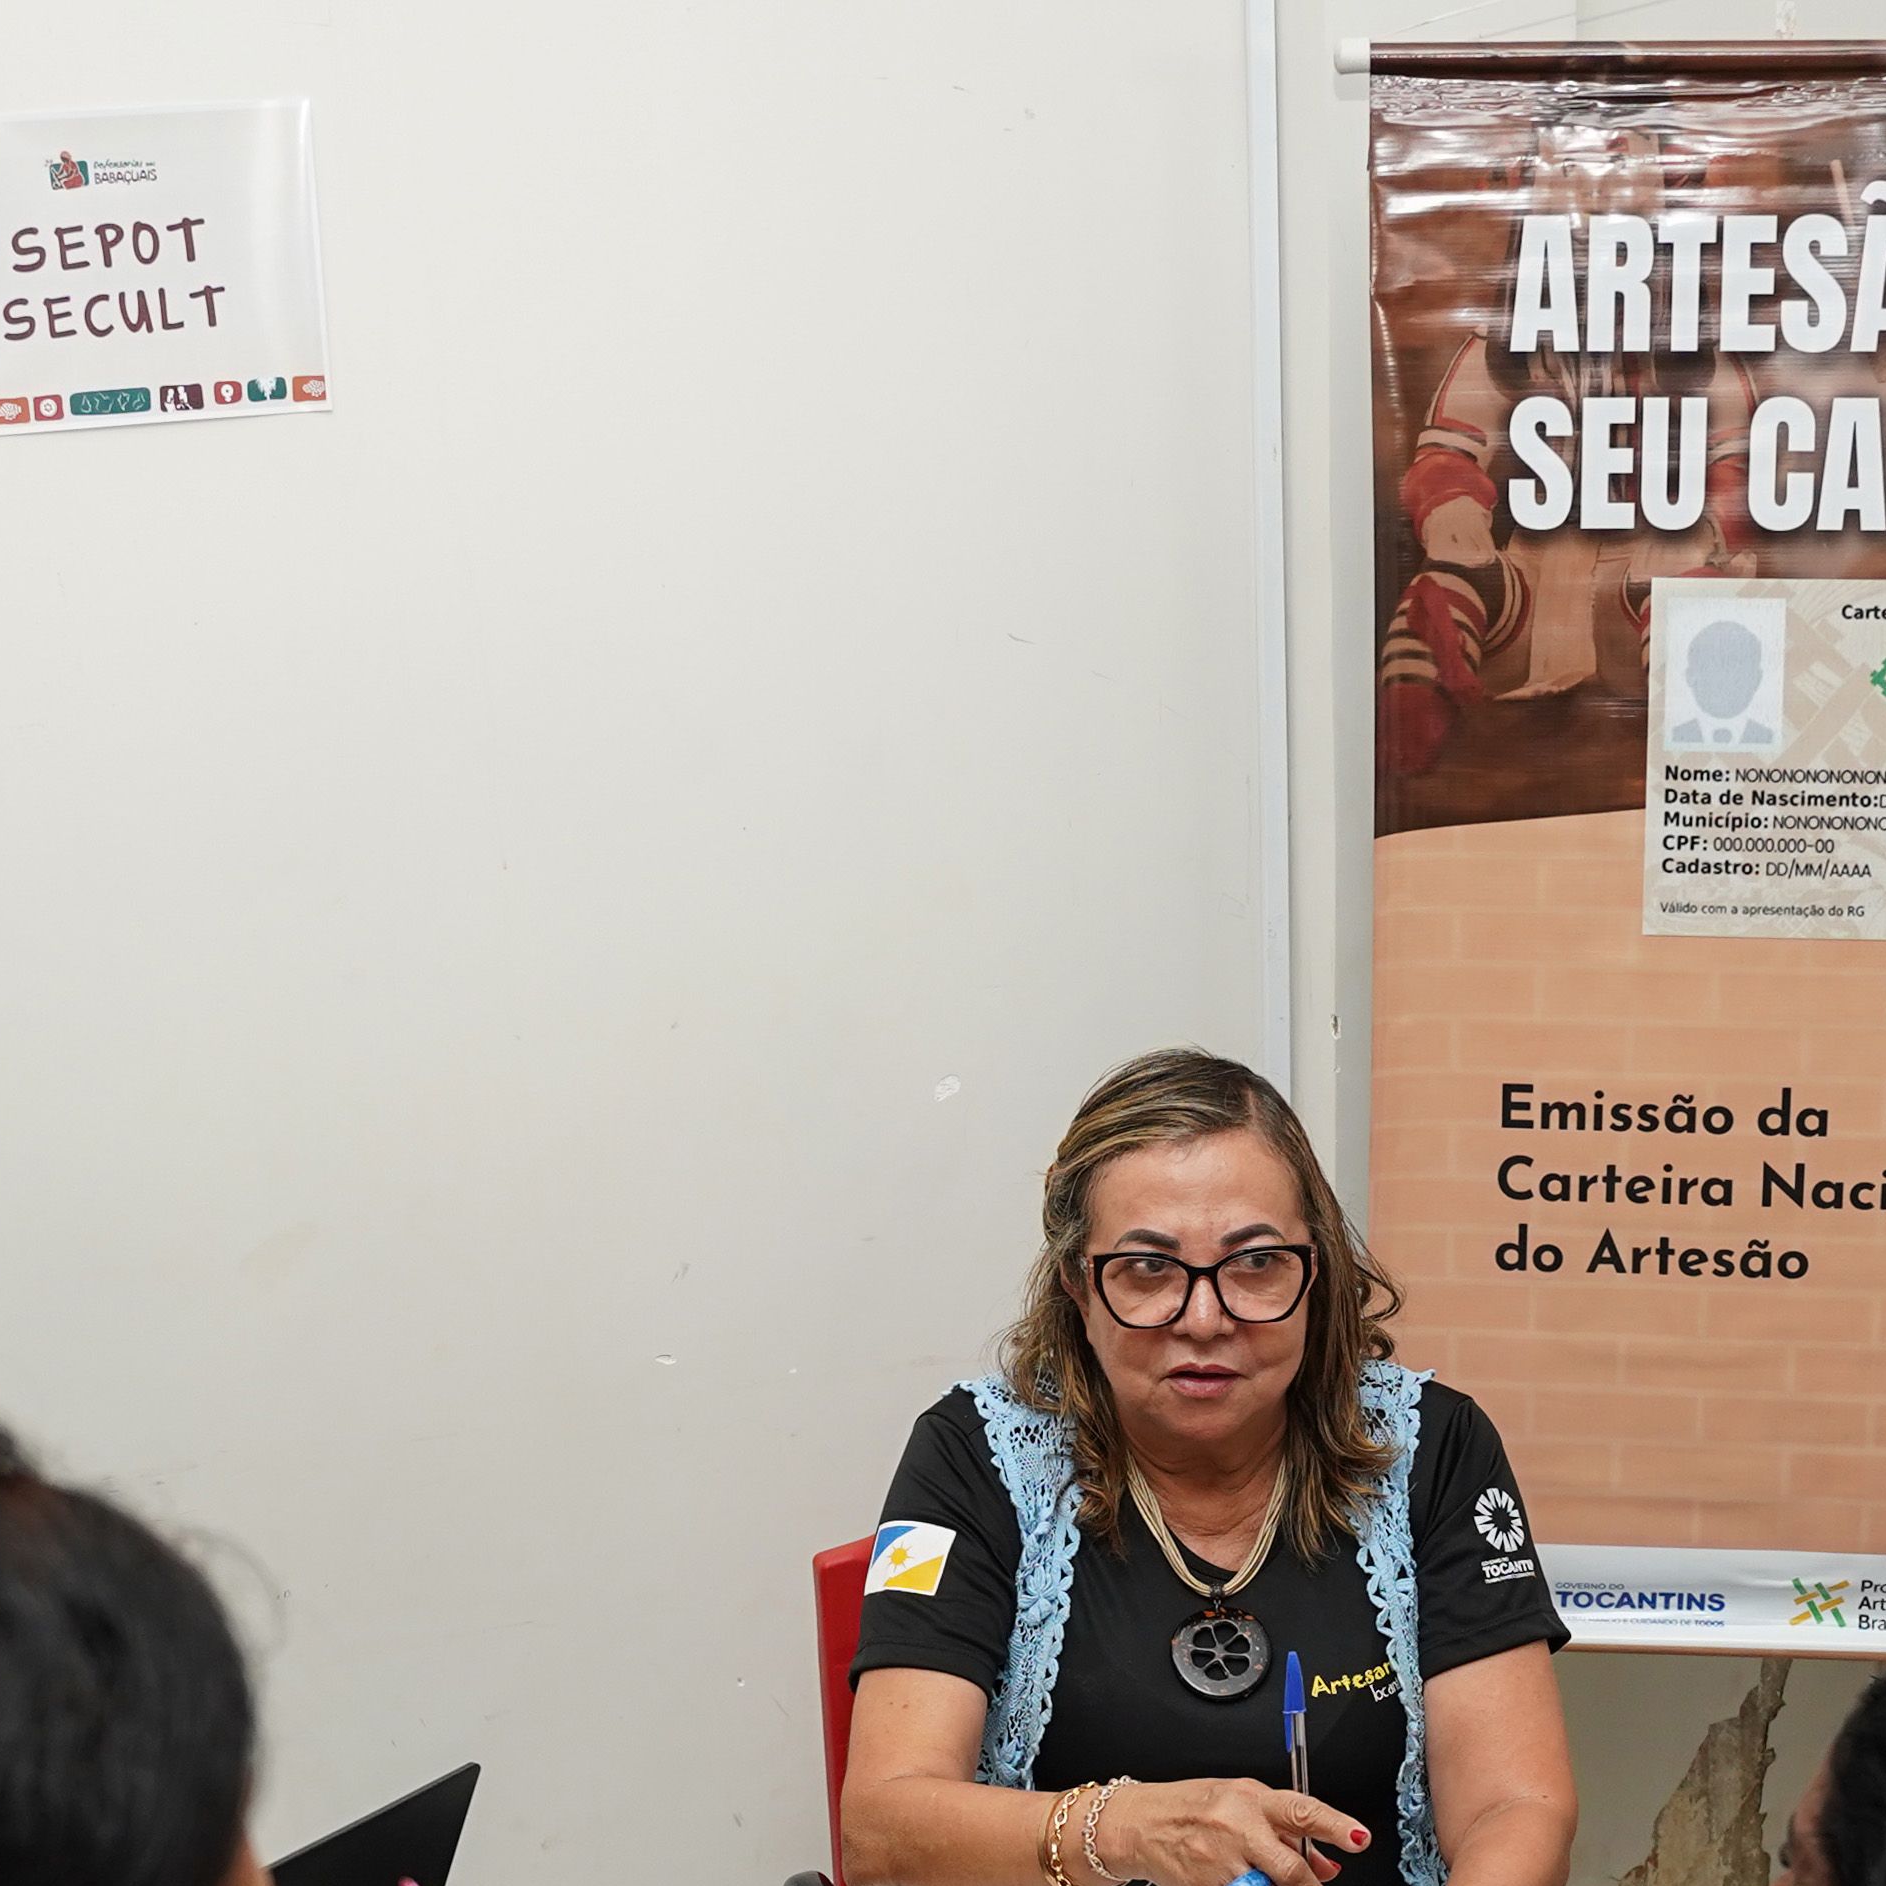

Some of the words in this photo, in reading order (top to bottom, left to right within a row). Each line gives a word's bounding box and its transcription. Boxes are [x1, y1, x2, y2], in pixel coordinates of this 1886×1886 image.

[11, 217, 206, 273] SEPOT
[3, 285, 225, 341] SECULT
[1507, 395, 1707, 532] SEU
[1664, 765, 1731, 784] Nome:
[1664, 788, 1715, 805] Data
[1720, 789, 1744, 806] de
[1664, 811, 1768, 831] Município:
[1663, 835, 1708, 852] CPF:
[1713, 837, 1835, 854] 000.000.000-00
[1662, 858, 1760, 876] Cadastro:
[1766, 859, 1872, 880] DD/MM/AAAA
[1660, 902, 1698, 914] Válido
[1701, 905, 1727, 915] com
[1731, 906, 1737, 915] a
[1741, 904, 1825, 919] apresentação
[1828, 904, 1845, 917] do
[1847, 905, 1865, 917] RG
[1500, 1083, 1735, 1136] Emissão
[1757, 1088, 1829, 1138] da
[1497, 1154, 1734, 1207] Carteira
[1495, 1223, 1564, 1273] do
[1586, 1227, 1810, 1280] Artesão
[1555, 1582, 1606, 1590] GOVERNO
[1555, 1591, 1726, 1612] TOCANTINS
